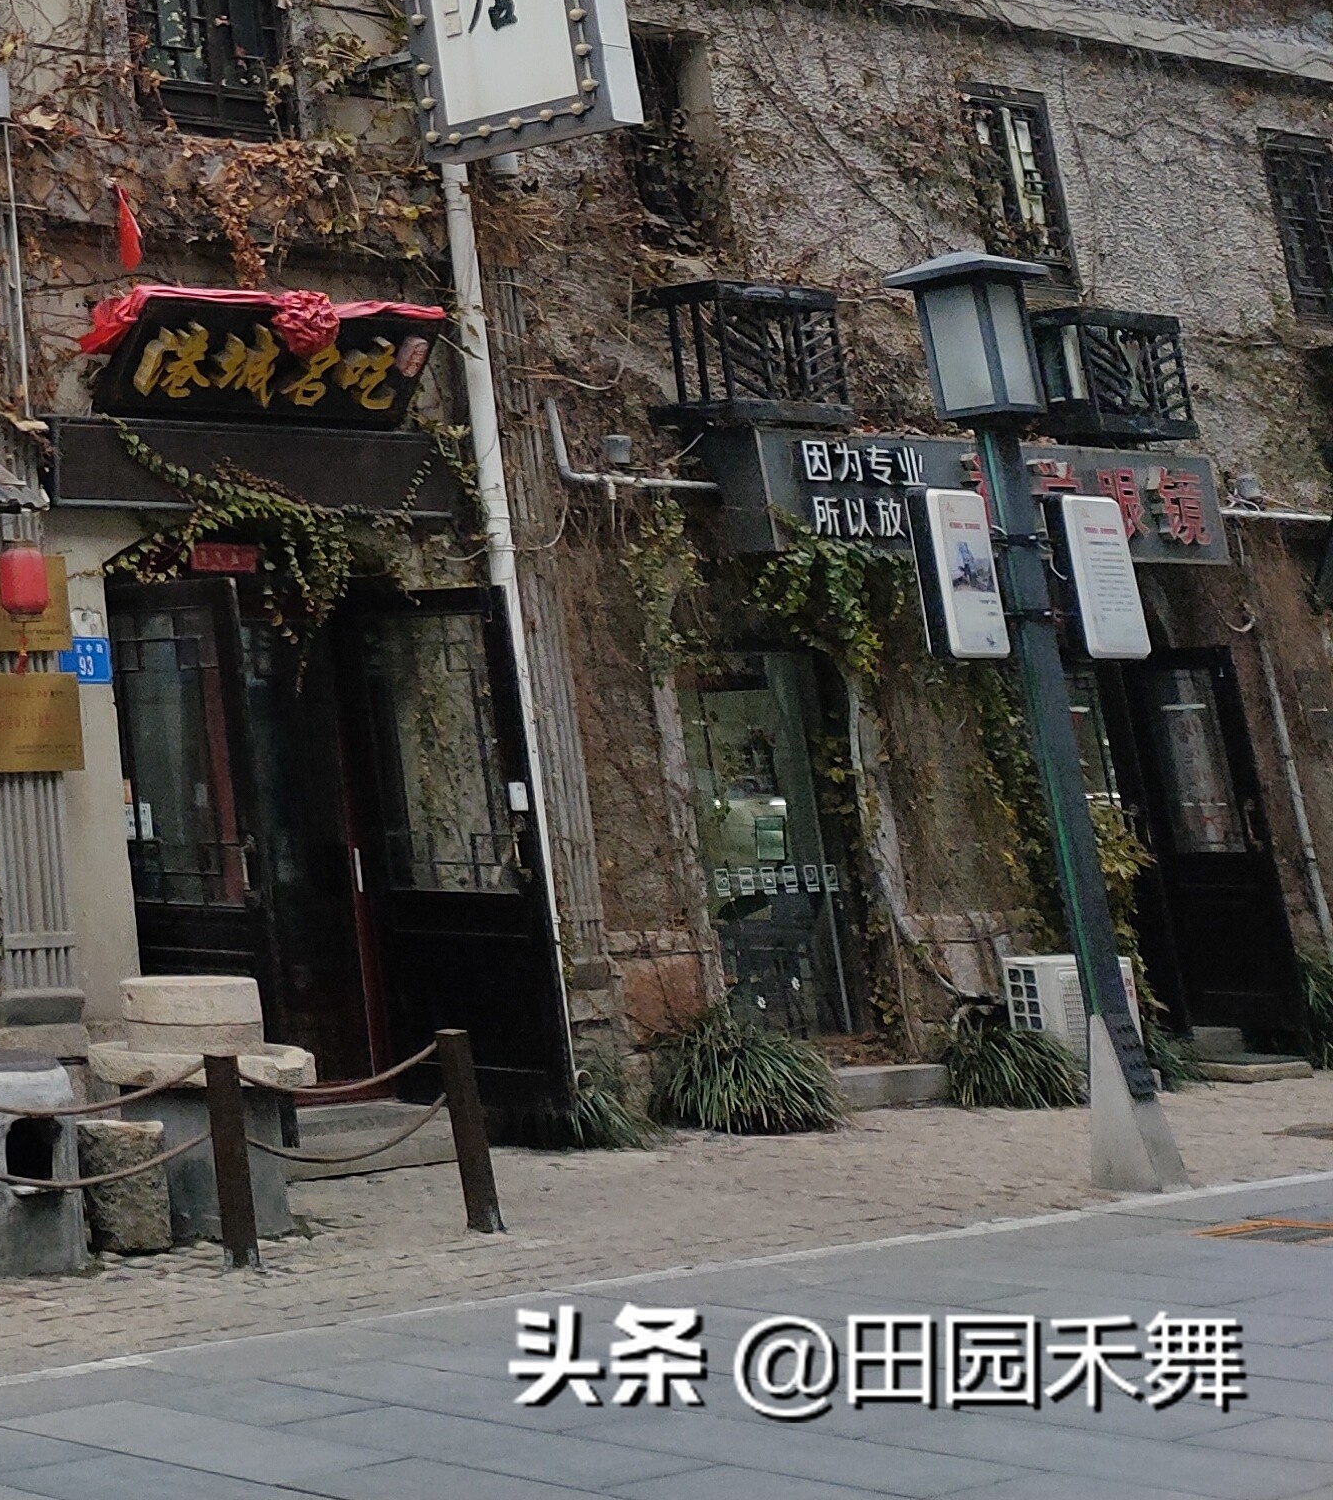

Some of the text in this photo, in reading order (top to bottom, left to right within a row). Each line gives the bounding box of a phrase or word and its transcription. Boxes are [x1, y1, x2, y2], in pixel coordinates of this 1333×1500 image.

[802, 440, 927, 487] 因为专业
[79, 655, 94, 676] 93
